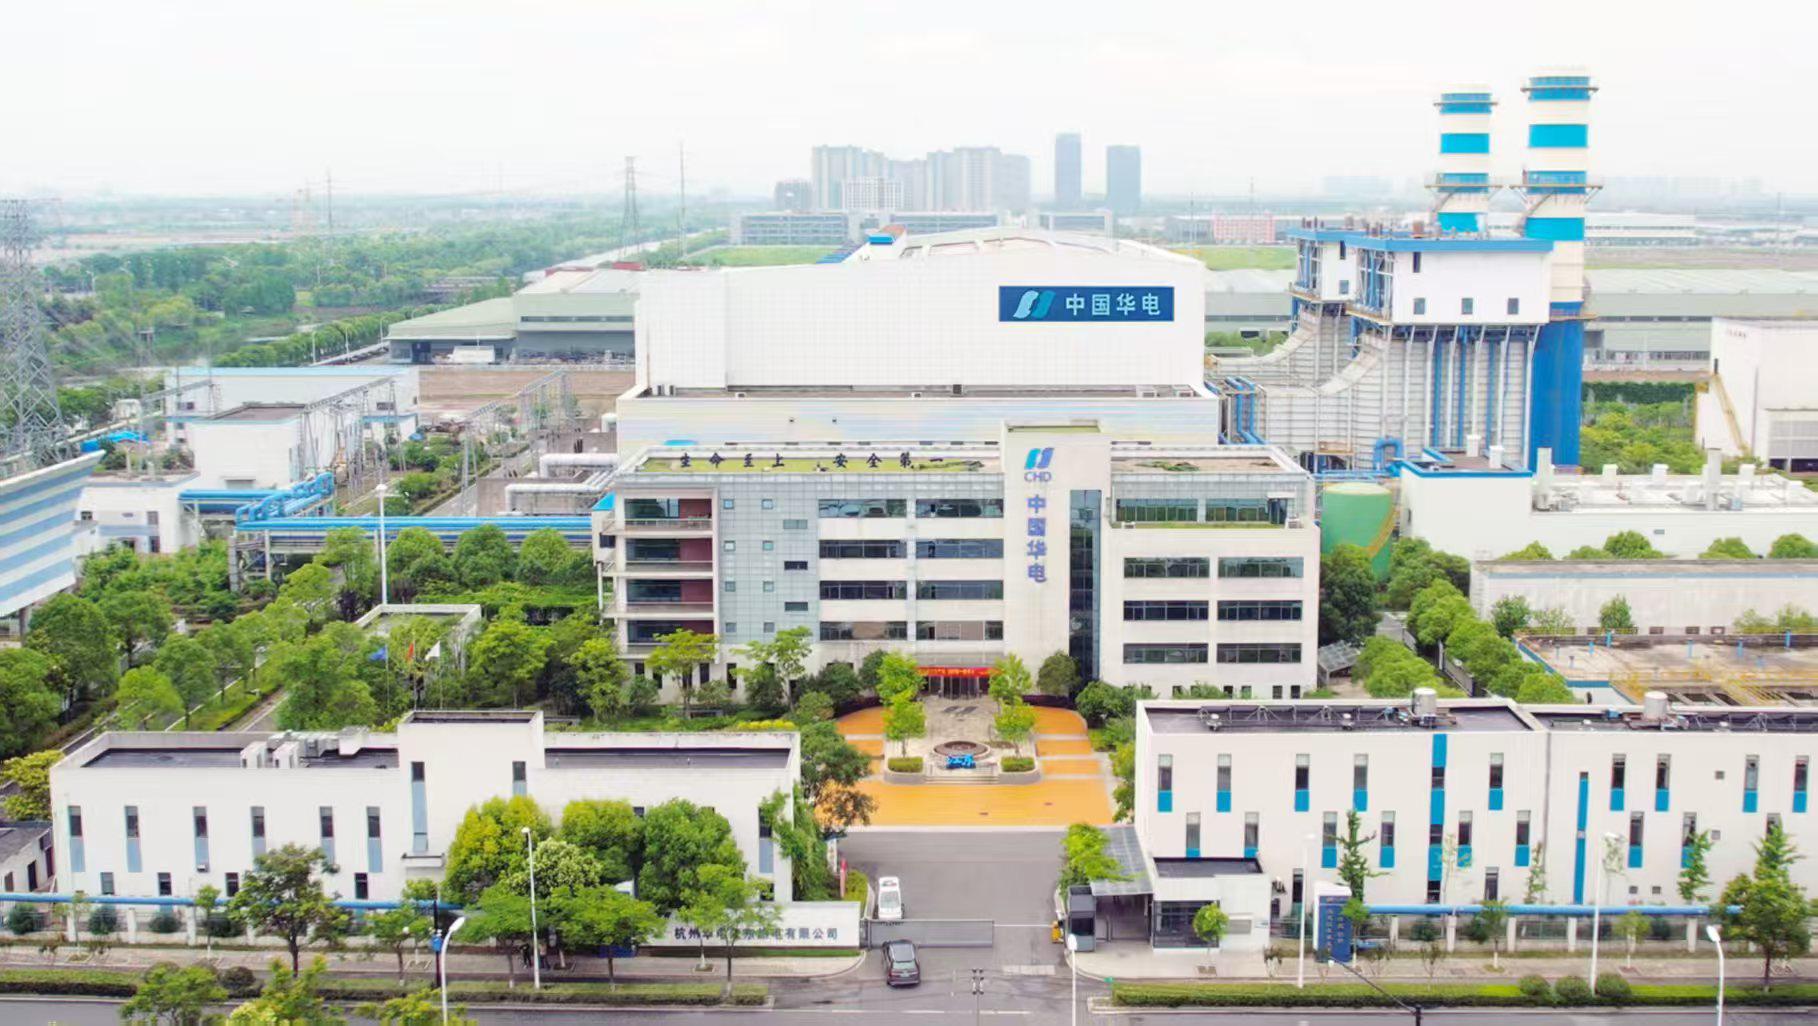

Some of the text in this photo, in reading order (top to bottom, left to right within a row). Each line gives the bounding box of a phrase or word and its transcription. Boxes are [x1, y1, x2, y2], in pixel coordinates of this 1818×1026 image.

[1065, 292, 1161, 316] 中国华电
[680, 452, 785, 469] 生命至上
[1023, 471, 1052, 483] CHD
[1026, 493, 1048, 584] 中国华电
